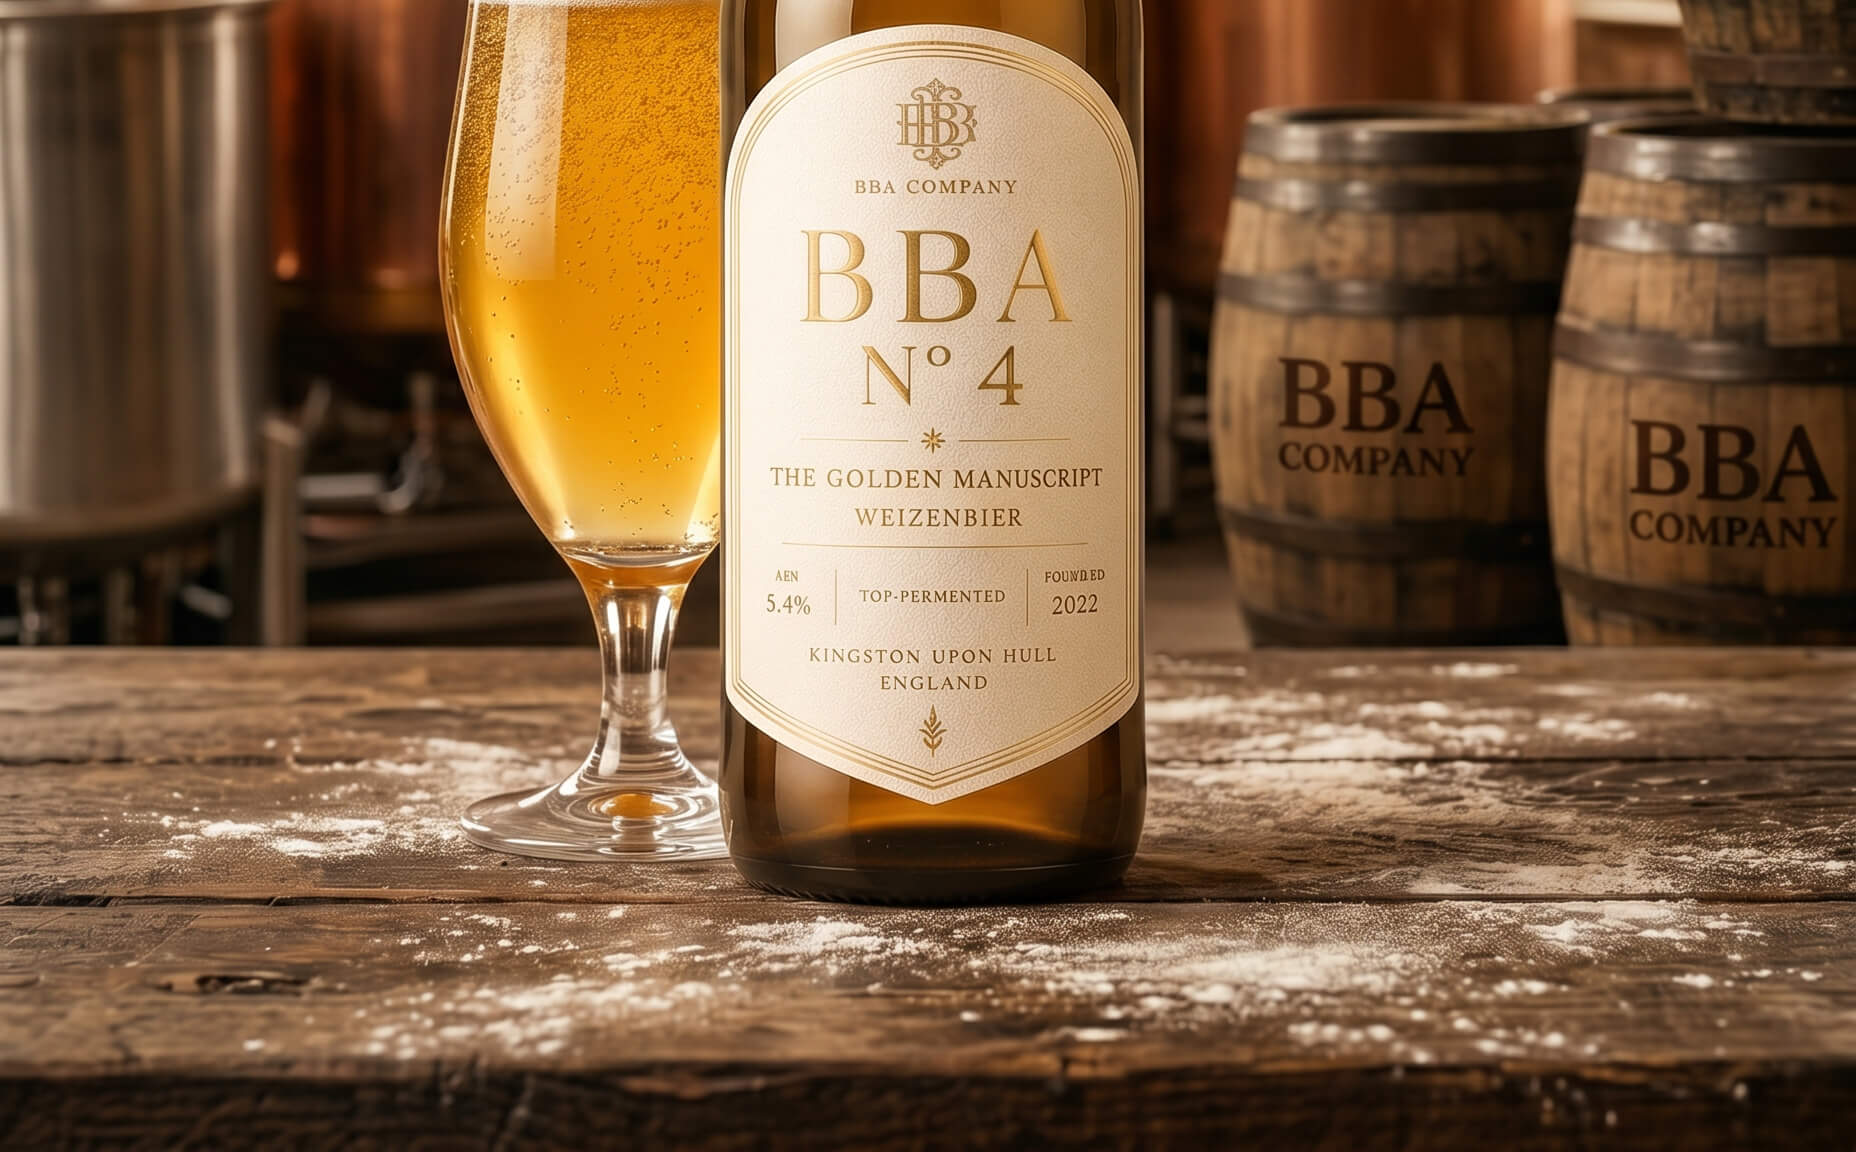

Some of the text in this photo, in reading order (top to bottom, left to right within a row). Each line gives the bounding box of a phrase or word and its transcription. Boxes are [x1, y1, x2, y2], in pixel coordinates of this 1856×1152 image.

[854, 179, 1018, 195] BBA COMPANY
[800, 228, 1073, 324] BBA
[977, 344, 1024, 406] 4
[1278, 357, 1475, 435] BBA
[1278, 441, 1477, 478] COMPANY
[1629, 419, 1839, 503] BBA
[770, 466, 1104, 489] THE GOLDEN MANUSCRIPT
[854, 507, 1024, 528] WEIZENBIER
[1628, 509, 1840, 549] COMPANY
[775, 569, 799, 582] AEN
[766, 593, 811, 615] 5.4%
[859, 589, 1006, 603] TOP-PERMENTED
[1052, 594, 1098, 615] 2022
[808, 647, 1057, 665] KINGSTON UPON HULL
[880, 675, 988, 691] ENGLAND
